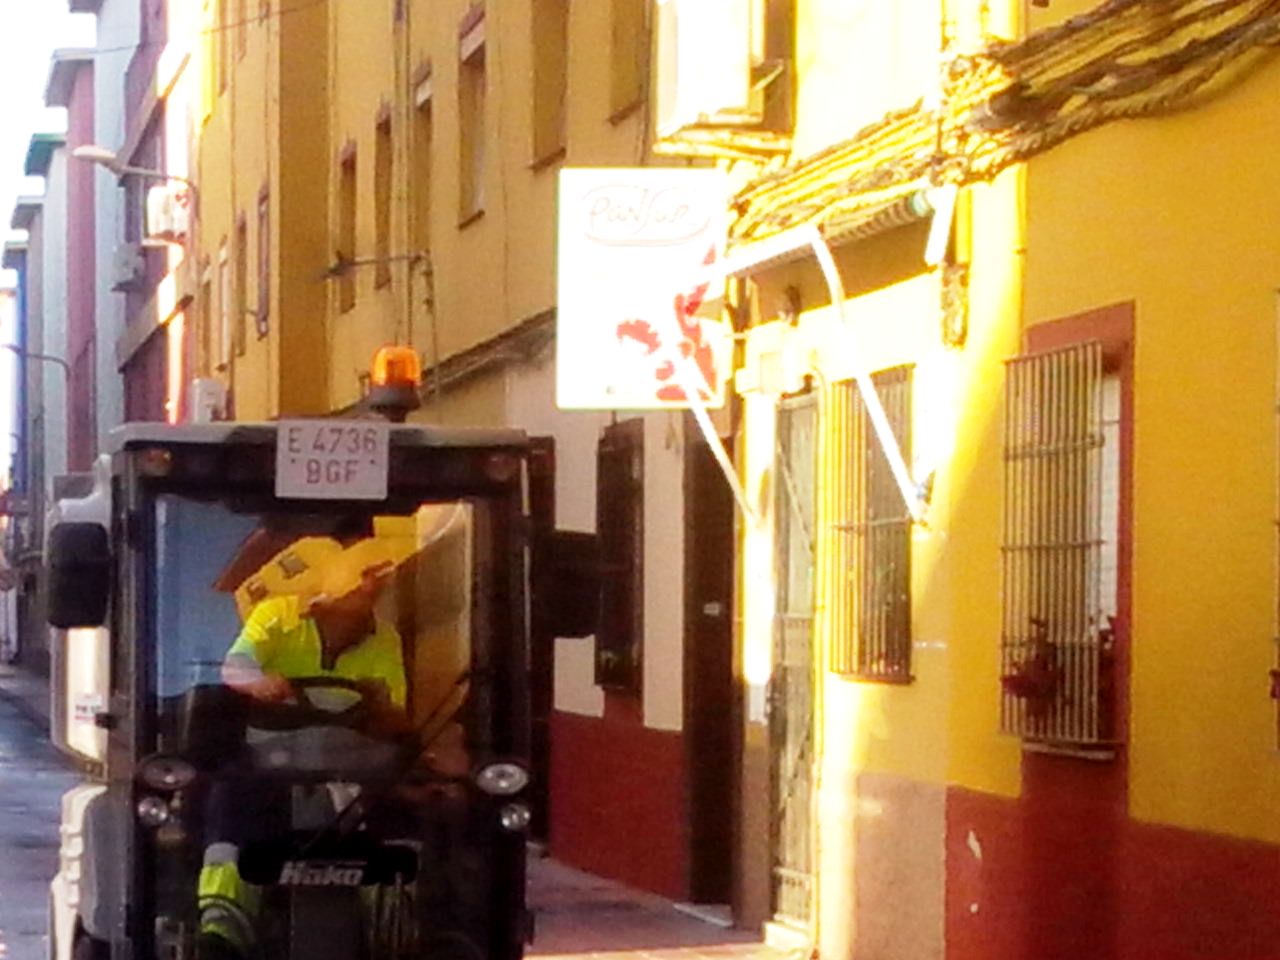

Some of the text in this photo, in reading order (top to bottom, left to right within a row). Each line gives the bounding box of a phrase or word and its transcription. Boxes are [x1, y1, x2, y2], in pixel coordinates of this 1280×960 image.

[288, 427, 377, 453] E 4736
[306, 458, 360, 484] BGF
[278, 860, 364, 885] Hako
